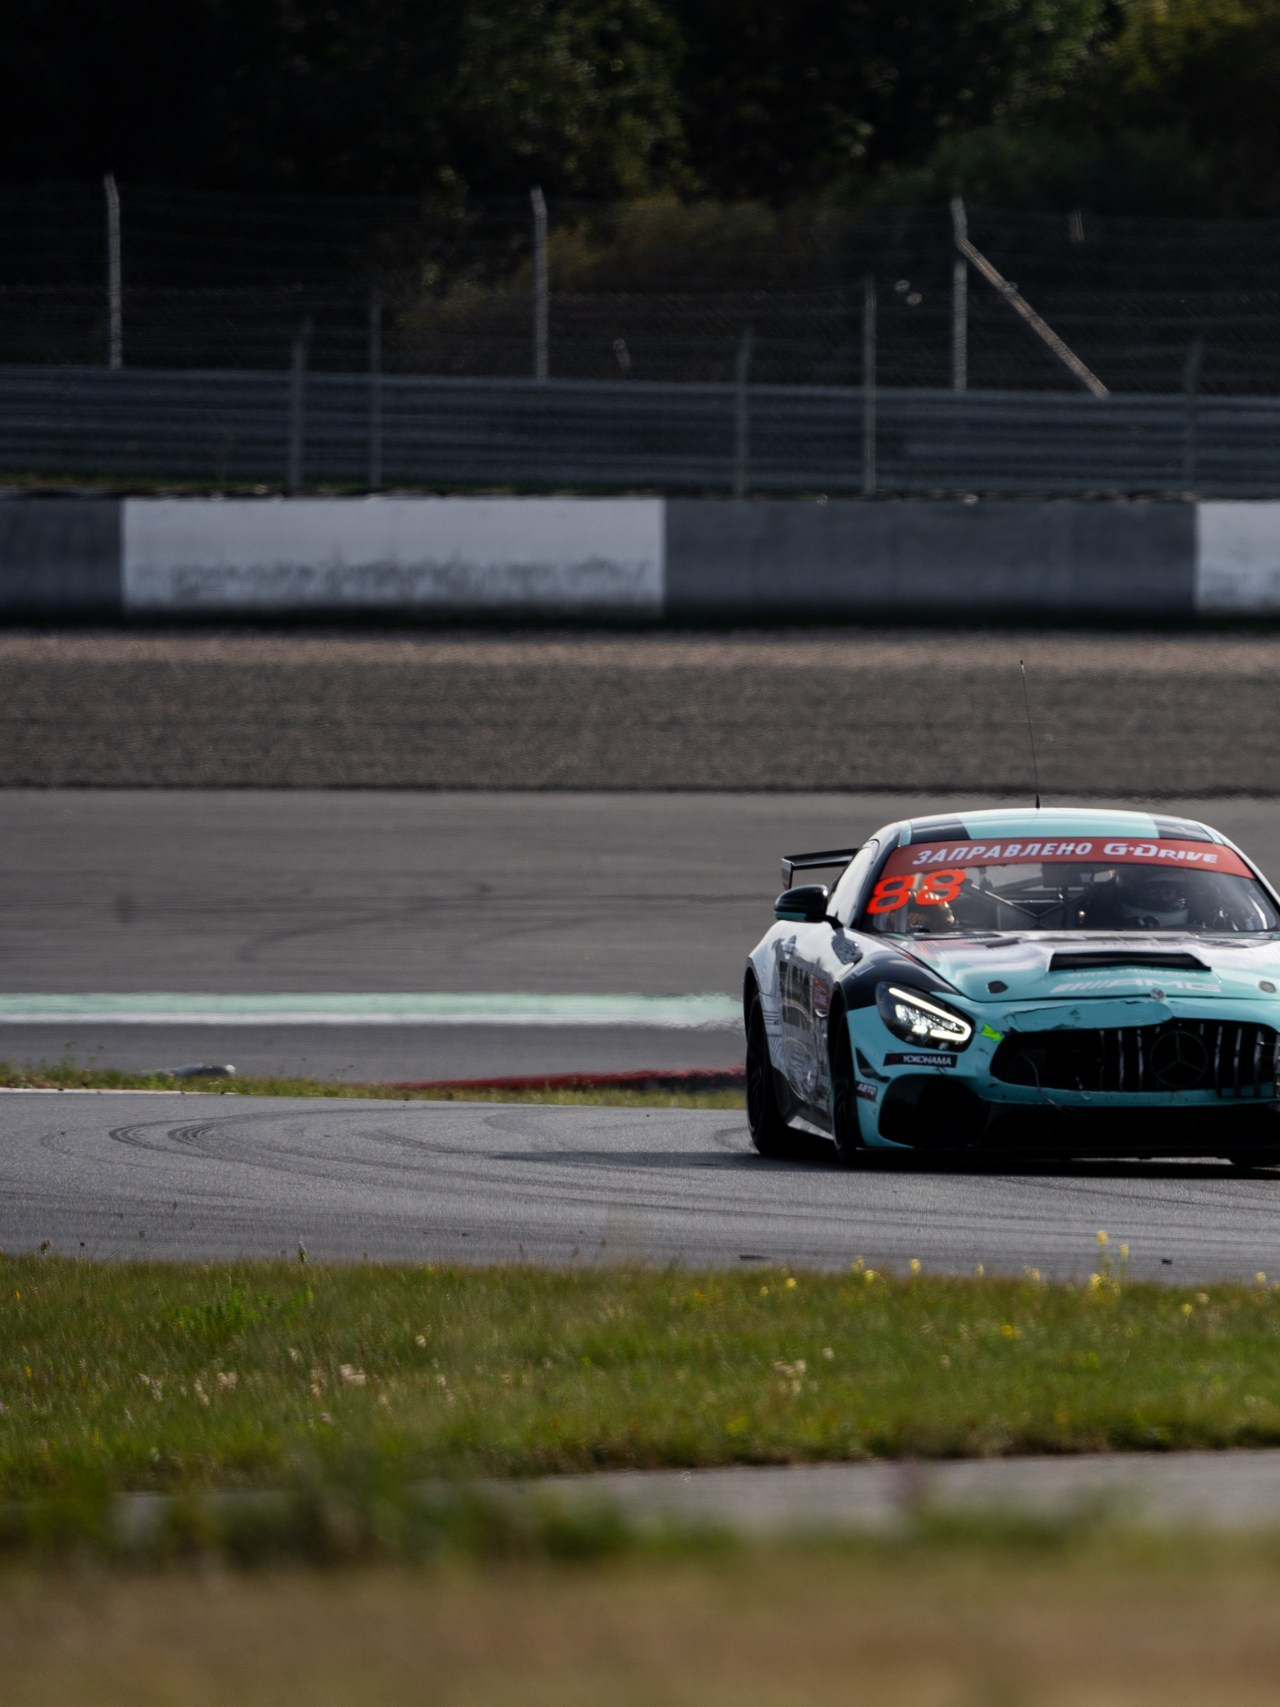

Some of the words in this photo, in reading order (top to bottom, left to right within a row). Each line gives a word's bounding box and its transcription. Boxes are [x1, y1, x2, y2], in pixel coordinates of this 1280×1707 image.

[912, 842, 1092, 865] ЗАПРАВЛЕНО
[866, 869, 967, 915] 88
[902, 1055, 952, 1065] YOKOHAMA
